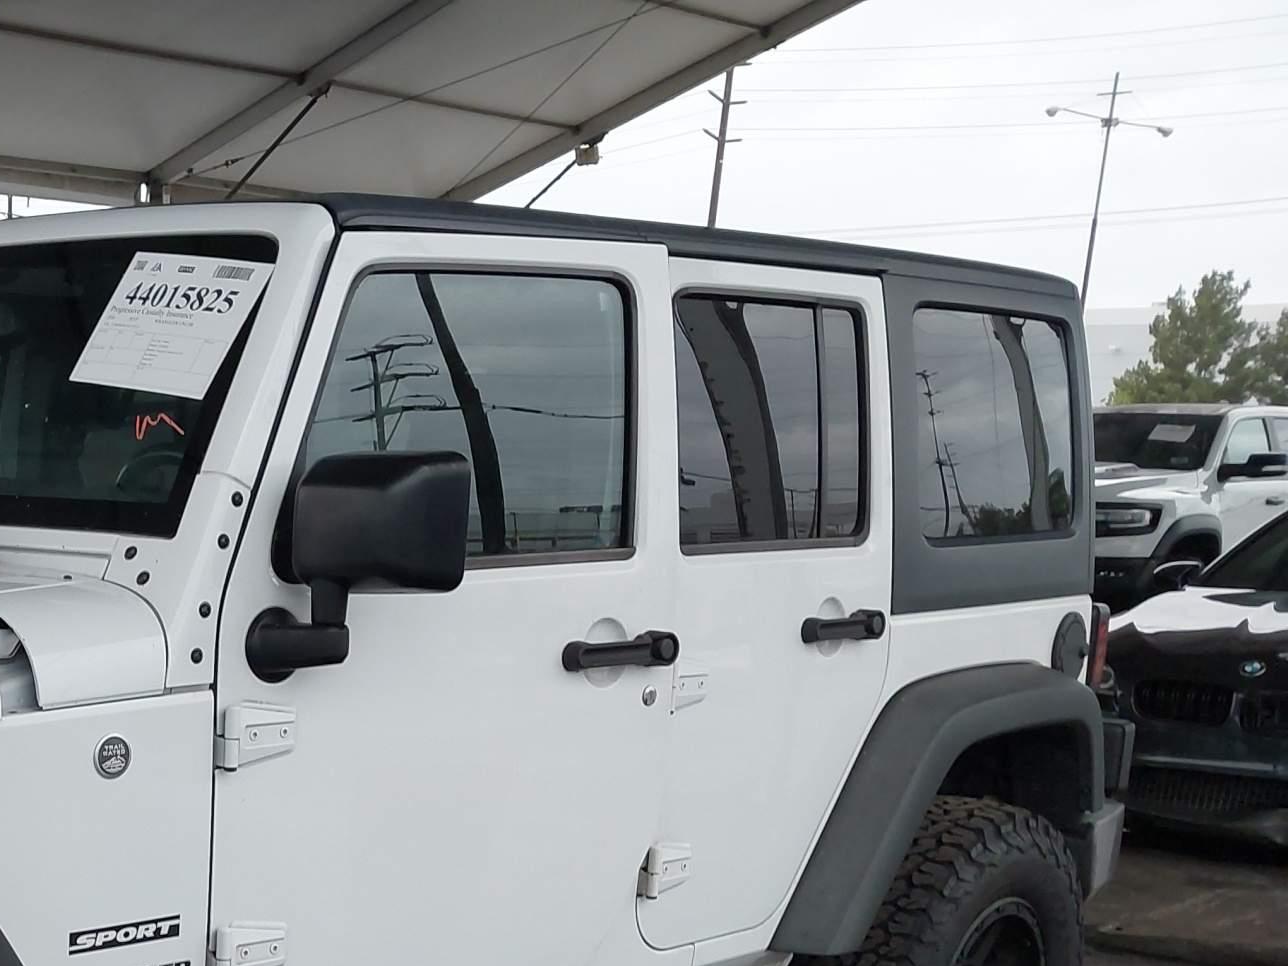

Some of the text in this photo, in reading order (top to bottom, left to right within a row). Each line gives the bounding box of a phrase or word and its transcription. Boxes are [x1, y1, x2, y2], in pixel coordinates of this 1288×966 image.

[125, 281, 241, 314] 44015825
[105, 743, 125, 751] TRAIL
[70, 917, 180, 953] SPORT
